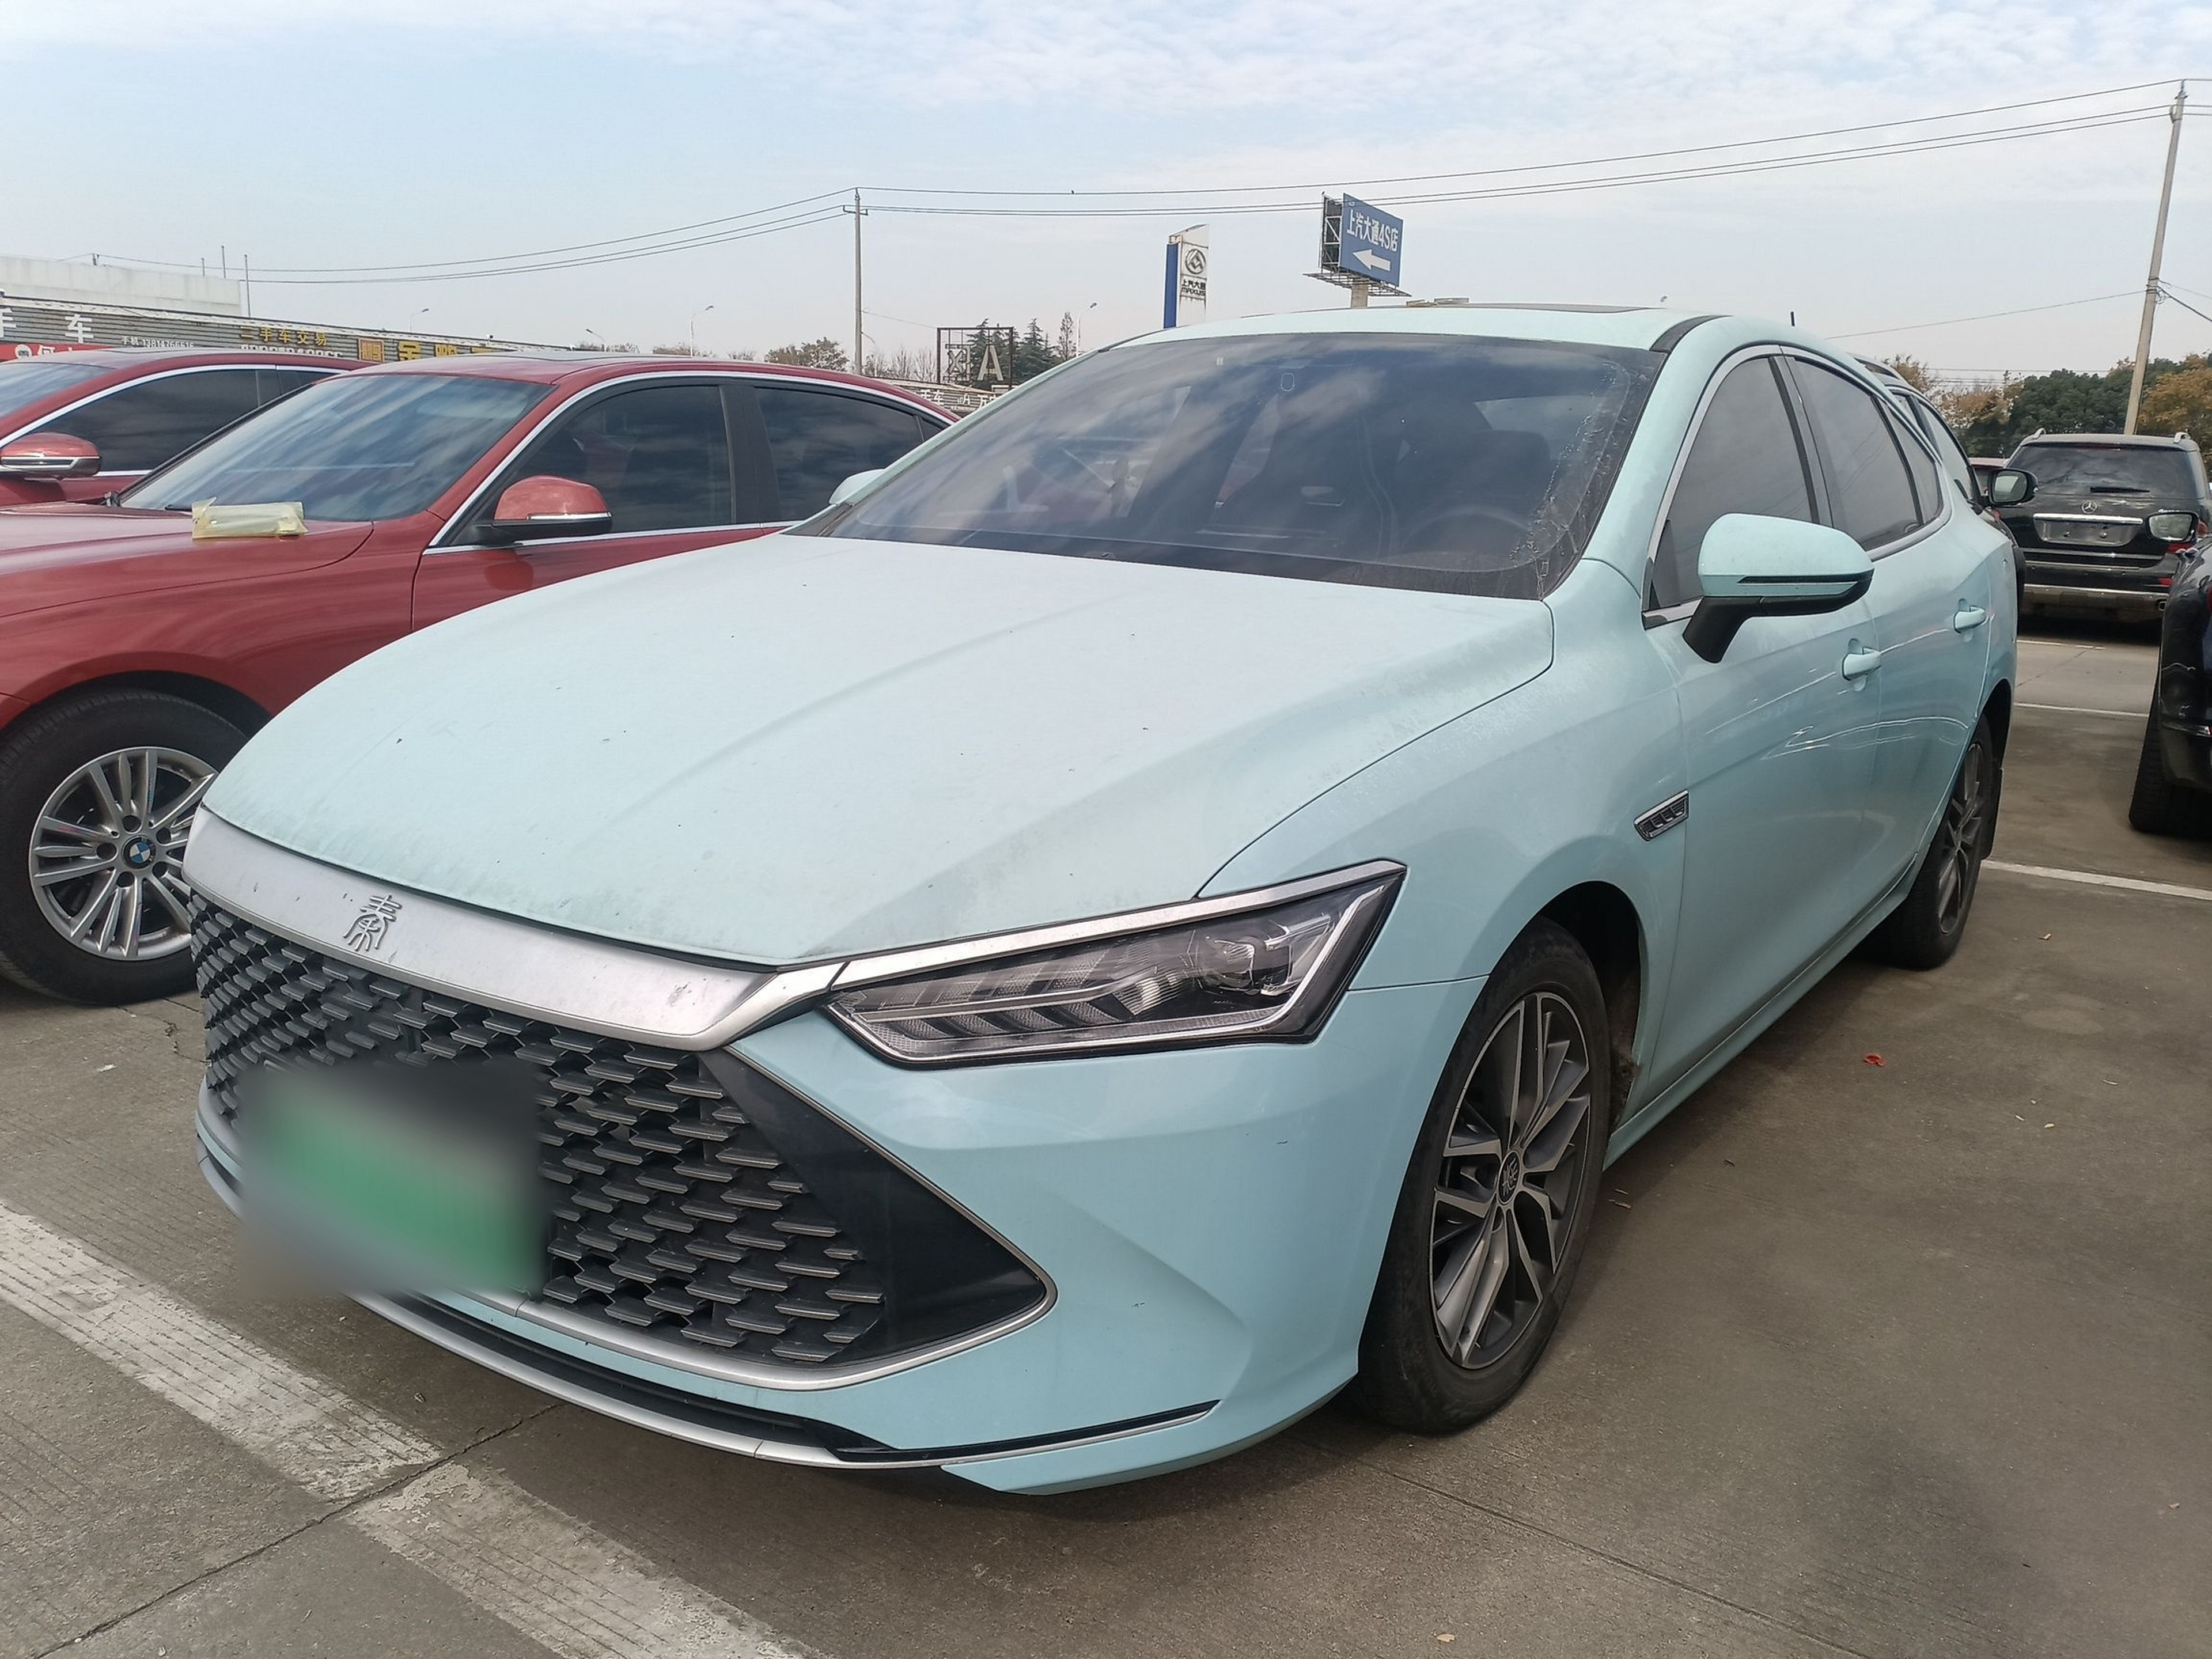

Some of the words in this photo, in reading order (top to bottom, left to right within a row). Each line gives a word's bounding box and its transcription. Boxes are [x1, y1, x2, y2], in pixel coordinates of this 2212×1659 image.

[1347, 209, 1398, 252] 上汽大通4S店
[240, 325, 328, 346] 二手车交易
[342, 895, 403, 952] 秦
